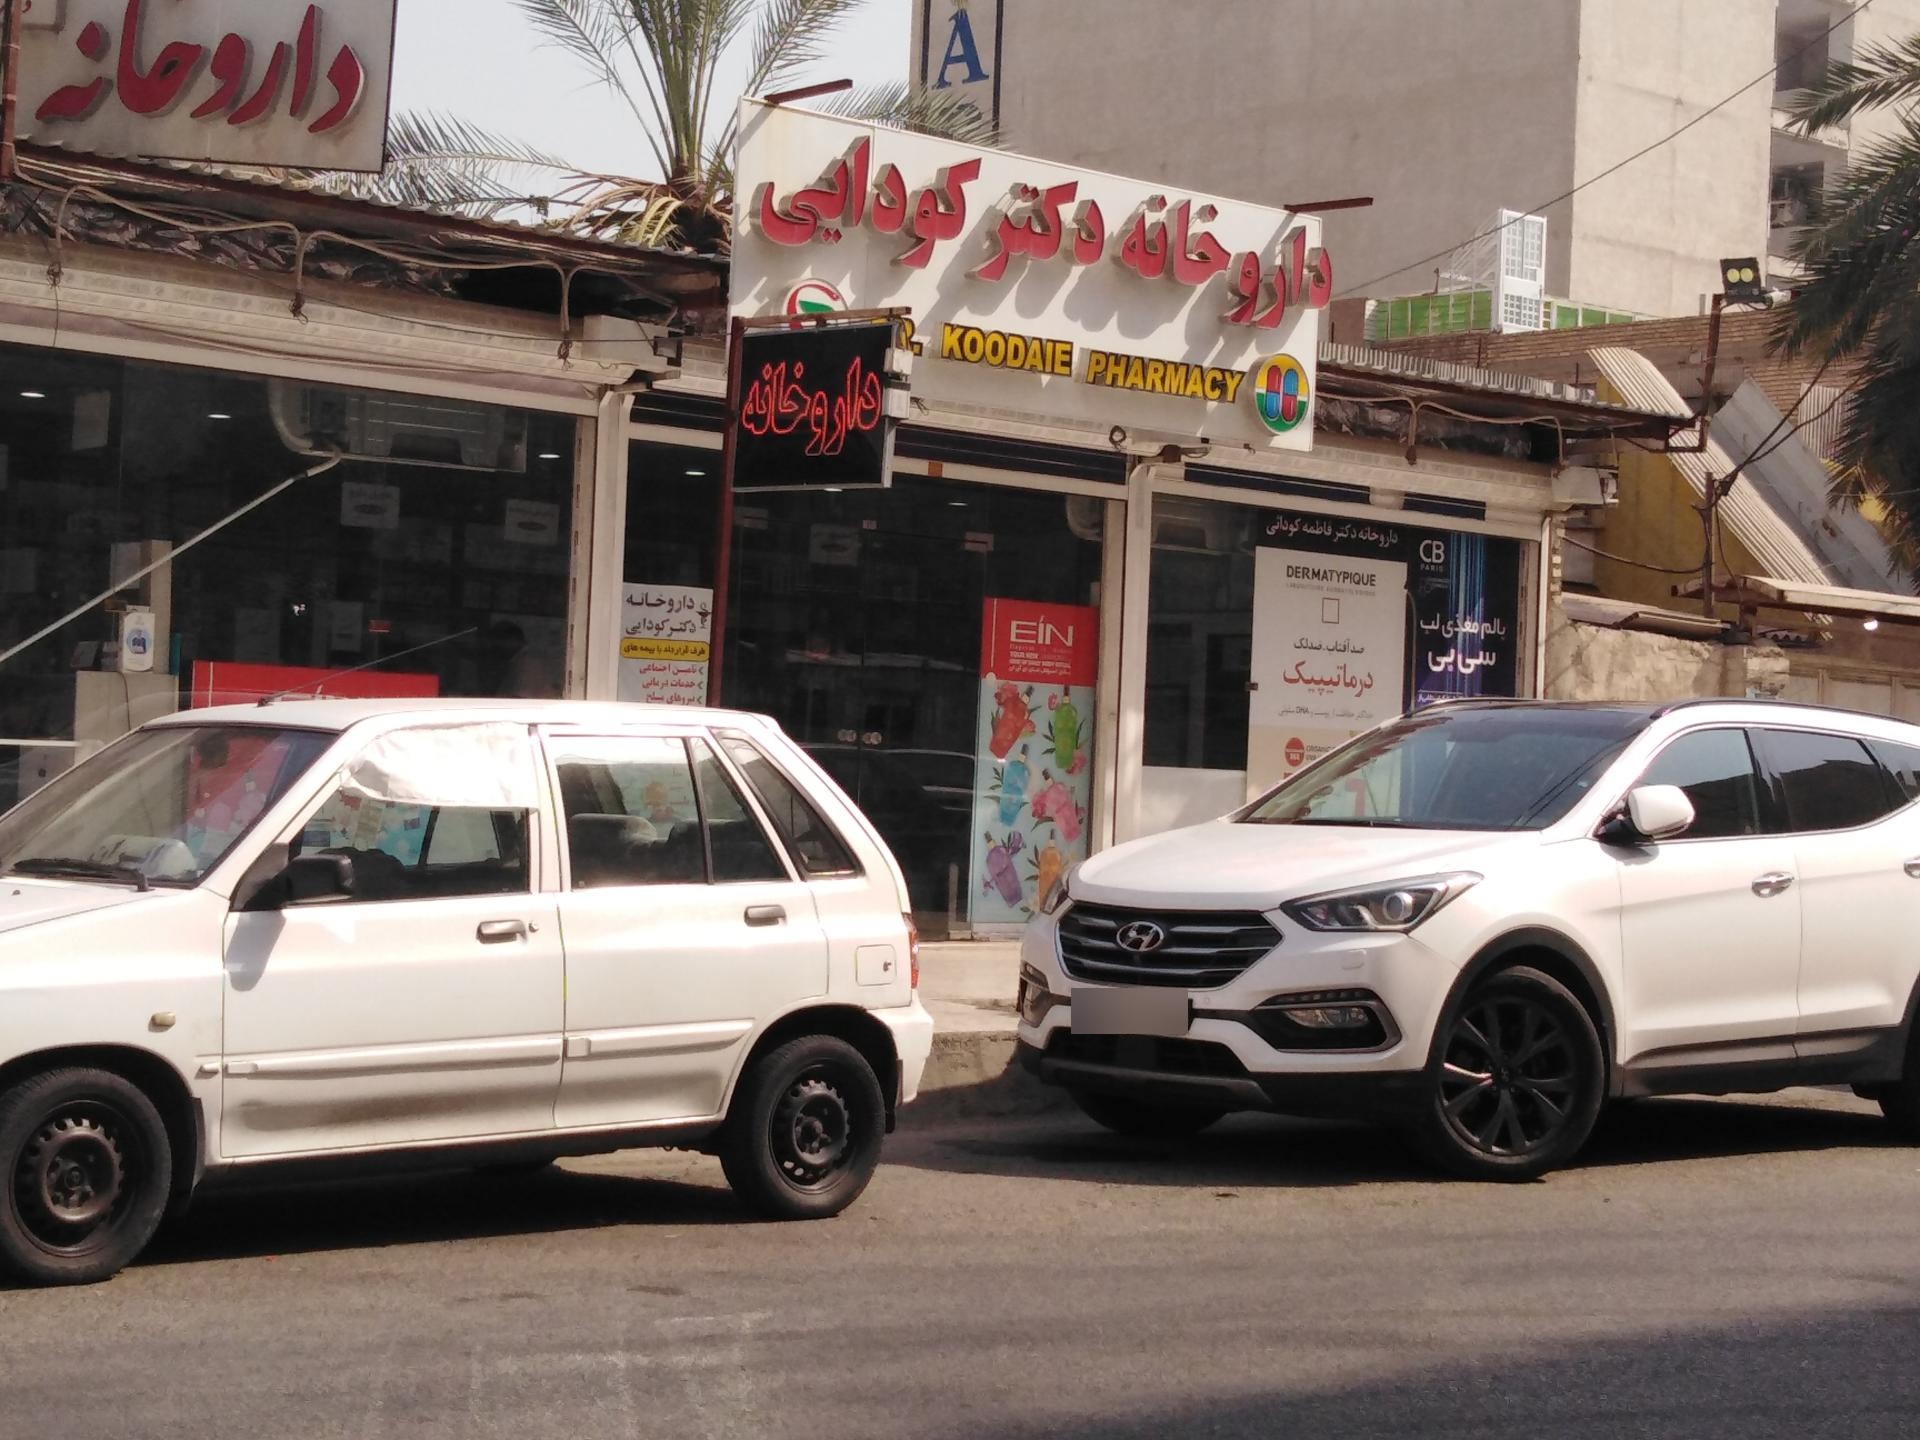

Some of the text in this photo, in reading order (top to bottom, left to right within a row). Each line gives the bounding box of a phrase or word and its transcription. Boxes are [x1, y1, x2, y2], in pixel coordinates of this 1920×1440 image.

[931, 8, 990, 90] A
[965, 179, 1105, 282] دکتر
[1119, 194, 1332, 329] داروخانه
[941, 322, 1075, 377] KOODAIE
[1085, 351, 1249, 403] PHARMACY
[742, 355, 882, 456] داروخانه
[1302, 519, 1332, 537] فاطمه
[1418, 539, 1446, 564] CB
[1286, 564, 1377, 587] DERMATYPIQUE
[625, 592, 695, 613] داروخانه
[667, 619, 697, 637] دکتر
[1419, 612, 1440, 635] لب
[1427, 647, 1497, 675] سی بی
[1282, 659, 1374, 698] درماتیپیک
